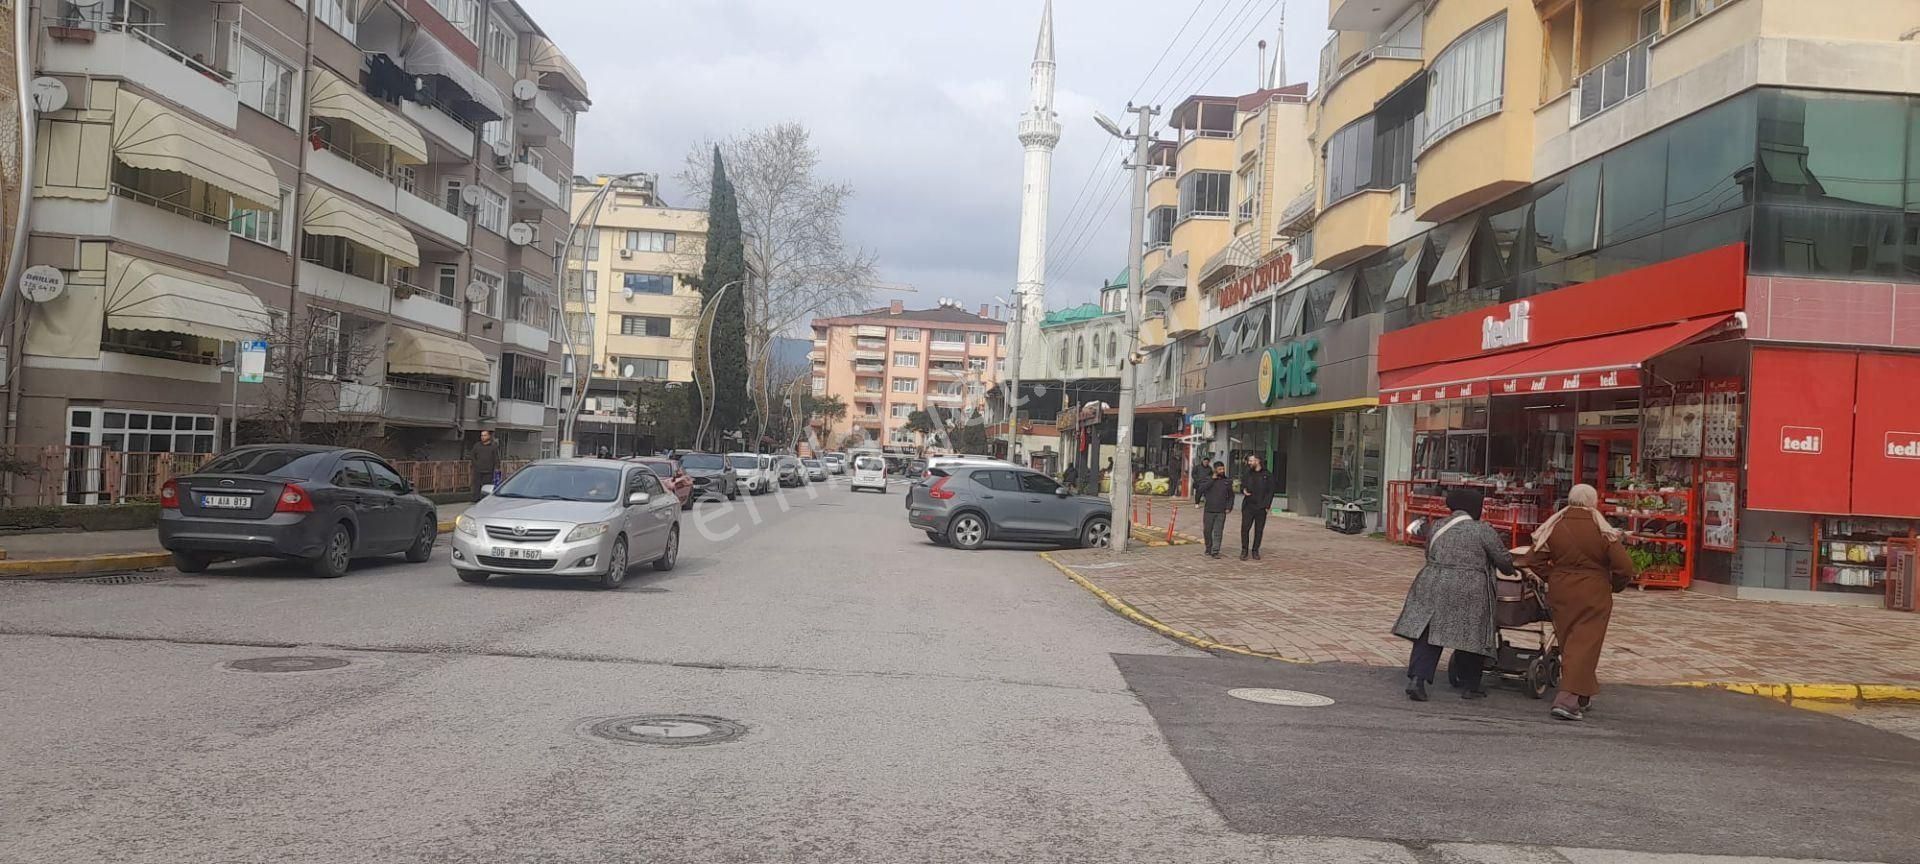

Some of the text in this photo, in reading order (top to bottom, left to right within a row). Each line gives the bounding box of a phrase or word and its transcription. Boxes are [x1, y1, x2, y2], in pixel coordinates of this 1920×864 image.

[1253, 252, 1293, 293] CENTER
[1481, 300, 1530, 350] tedi
[1503, 379, 1517, 392] tedi
[1531, 376, 1547, 391] tedi
[1563, 373, 1580, 389] tedi
[1600, 371, 1618, 387] tedi
[1783, 435, 1820, 452] tedi
[1887, 441, 1920, 457] tedi
